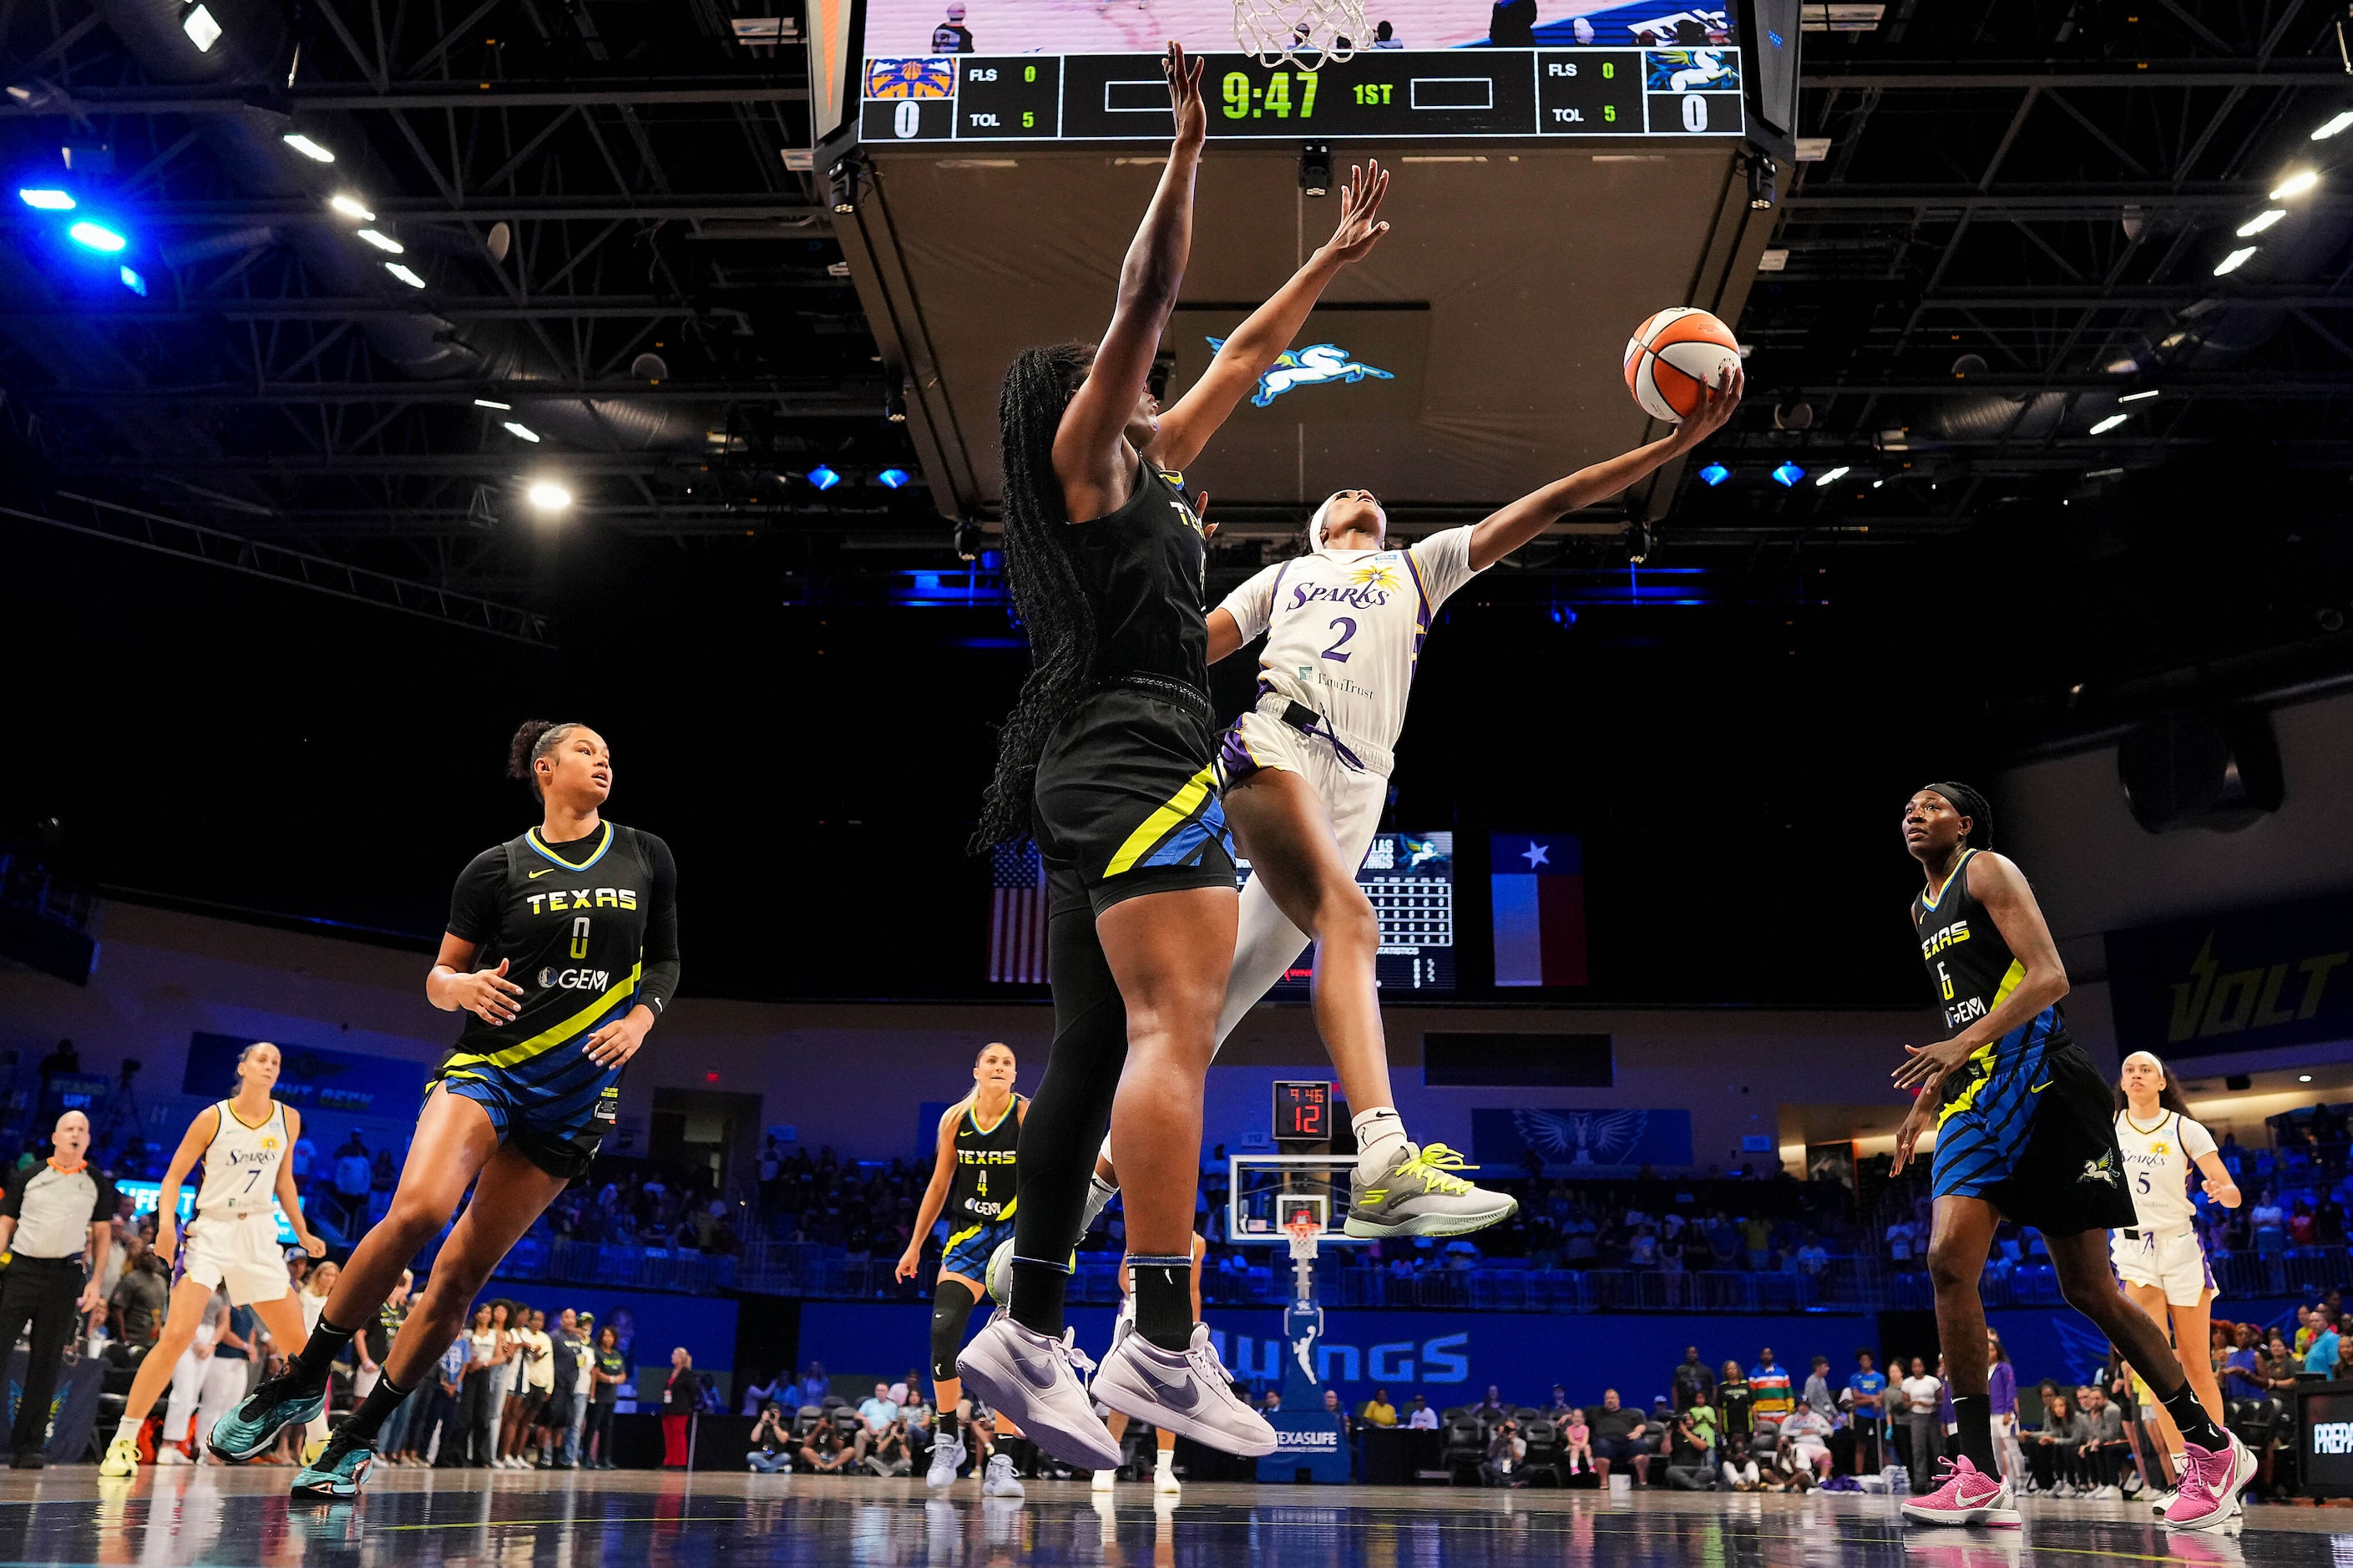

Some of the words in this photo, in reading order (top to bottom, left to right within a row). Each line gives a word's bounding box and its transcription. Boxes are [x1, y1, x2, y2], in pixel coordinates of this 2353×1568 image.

[969, 68, 998, 82] FLS
[1024, 66, 1036, 83] 0
[1549, 63, 1577, 78] FLS
[1602, 62, 1614, 79] 0
[1222, 71, 1318, 119] 9:47
[1353, 83, 1393, 105] 1ST
[893, 100, 919, 139] 0
[969, 113, 1000, 128] TOL
[1022, 111, 1035, 129] 5
[1552, 108, 1584, 123] TOL
[1603, 105, 1616, 123] 5
[1682, 94, 1708, 133] 0
[1321, 616, 1357, 663] 2
[526, 888, 638, 914] TEXAS
[569, 917, 590, 959] 0
[1921, 919, 1971, 960] EXAS
[558, 969, 610, 993] GEM
[1936, 961, 1955, 1000] 6
[2168, 928, 2350, 1043] VOLT
[1949, 996, 1986, 1024] GEM
[1295, 1105, 1320, 1133] 12
[957, 1149, 1017, 1165] TEXAS
[243, 1169, 261, 1194] 7
[976, 1170, 988, 1196] 4
[2135, 1171, 2152, 1195] 5
[974, 1201, 1001, 1216] GEM
[1208, 1328, 1469, 1383] WNGS
